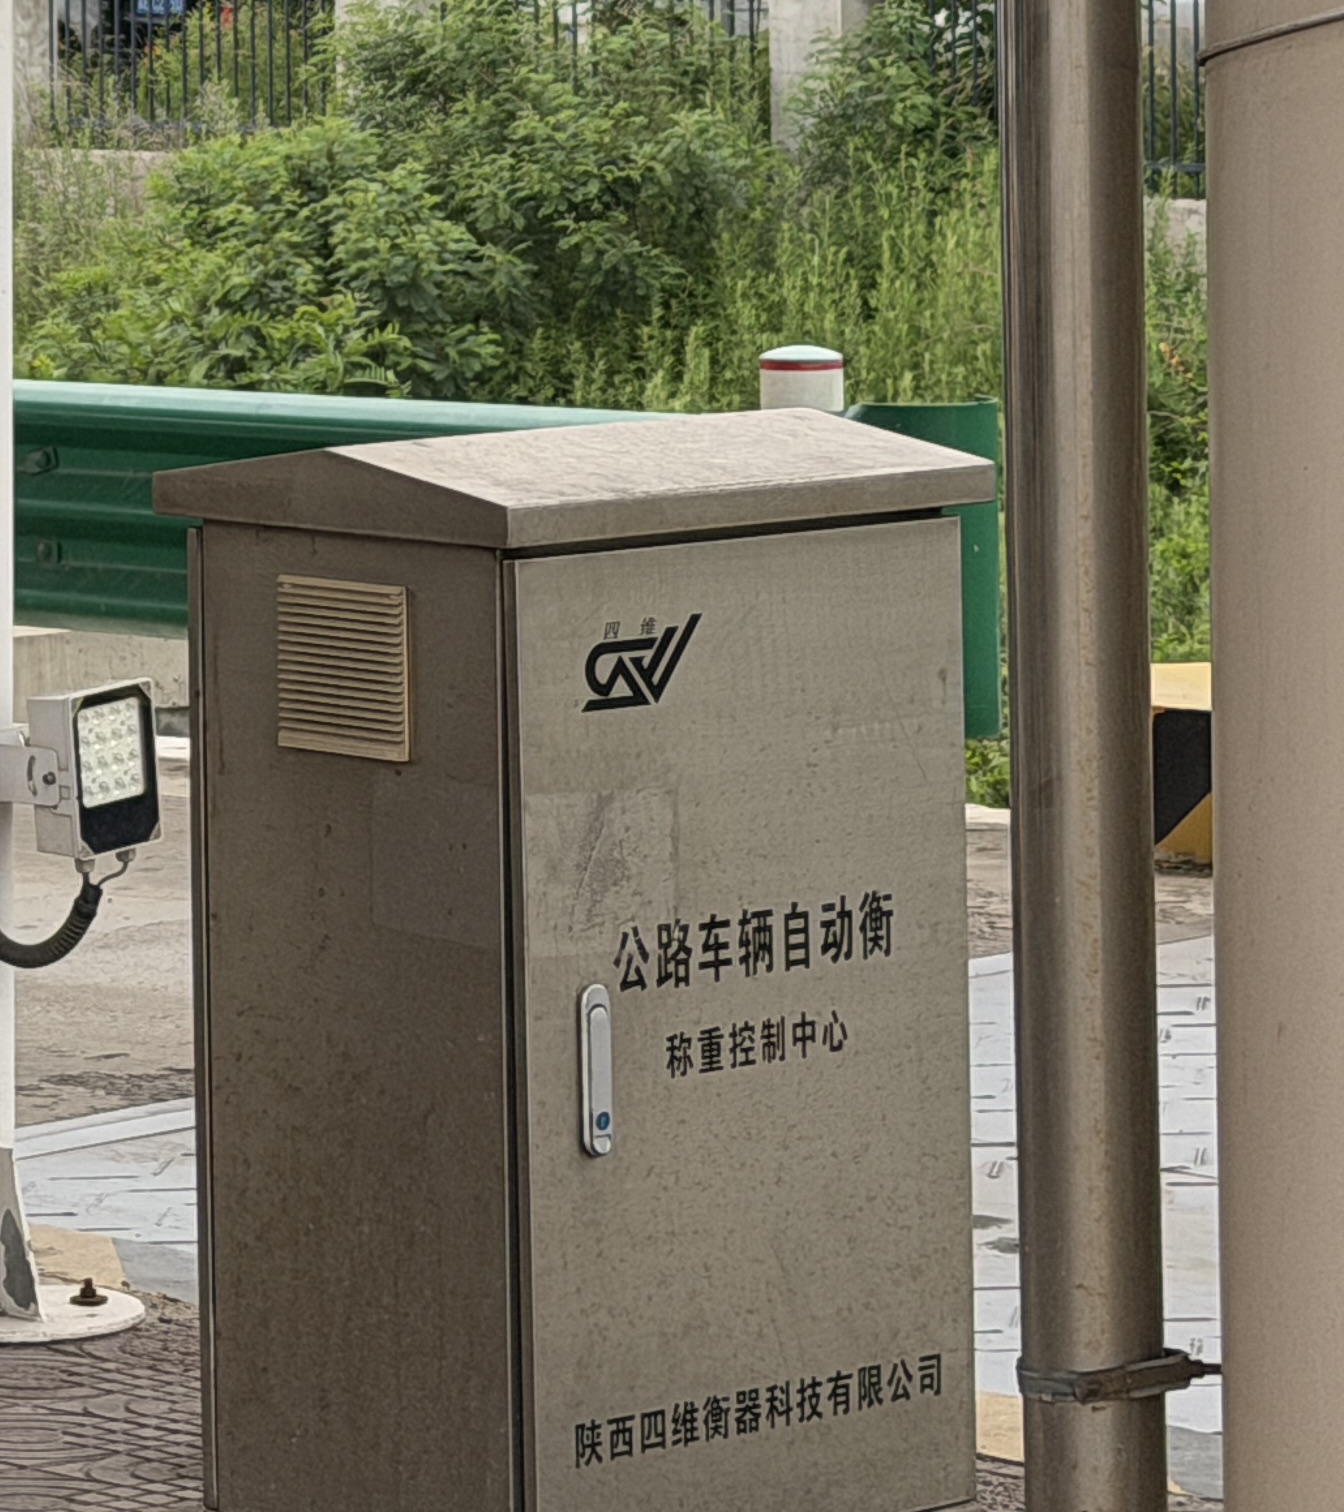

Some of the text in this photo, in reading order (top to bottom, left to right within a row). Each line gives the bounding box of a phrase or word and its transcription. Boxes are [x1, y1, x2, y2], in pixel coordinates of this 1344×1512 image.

[603, 617, 657, 640] 四维
[613, 890, 893, 992] 公路车辆自动衡
[665, 1010, 848, 1079] 称重控制中心
[574, 1353, 943, 1469] 陕西四维衡器科技有限公司
